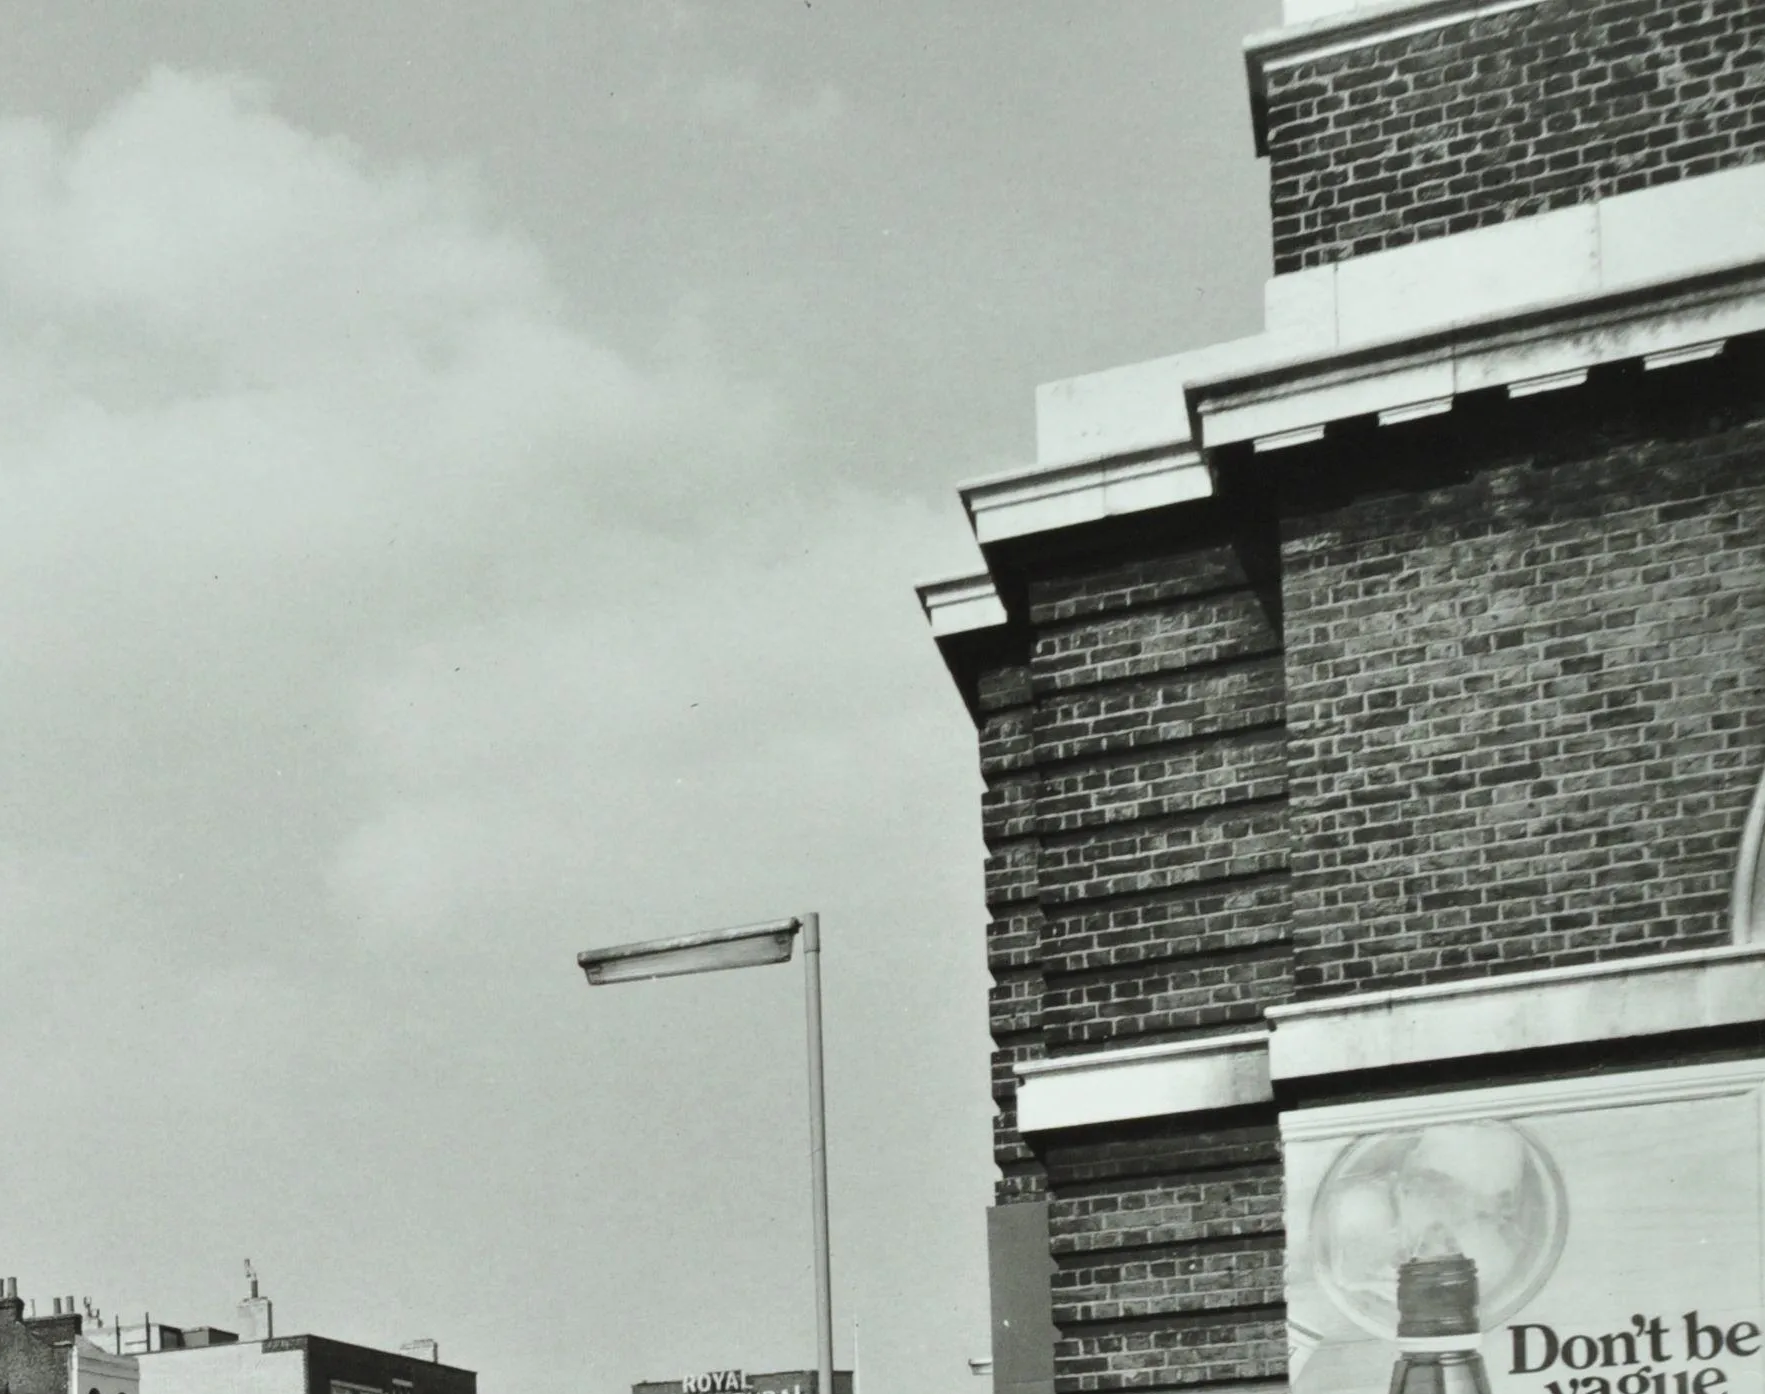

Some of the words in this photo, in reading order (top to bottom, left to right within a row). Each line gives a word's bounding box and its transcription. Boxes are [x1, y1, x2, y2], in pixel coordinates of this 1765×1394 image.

[1507, 1313, 1673, 1375] Don't
[1682, 1310, 1762, 1361] be
[682, 1369, 754, 1393] ROYAL
